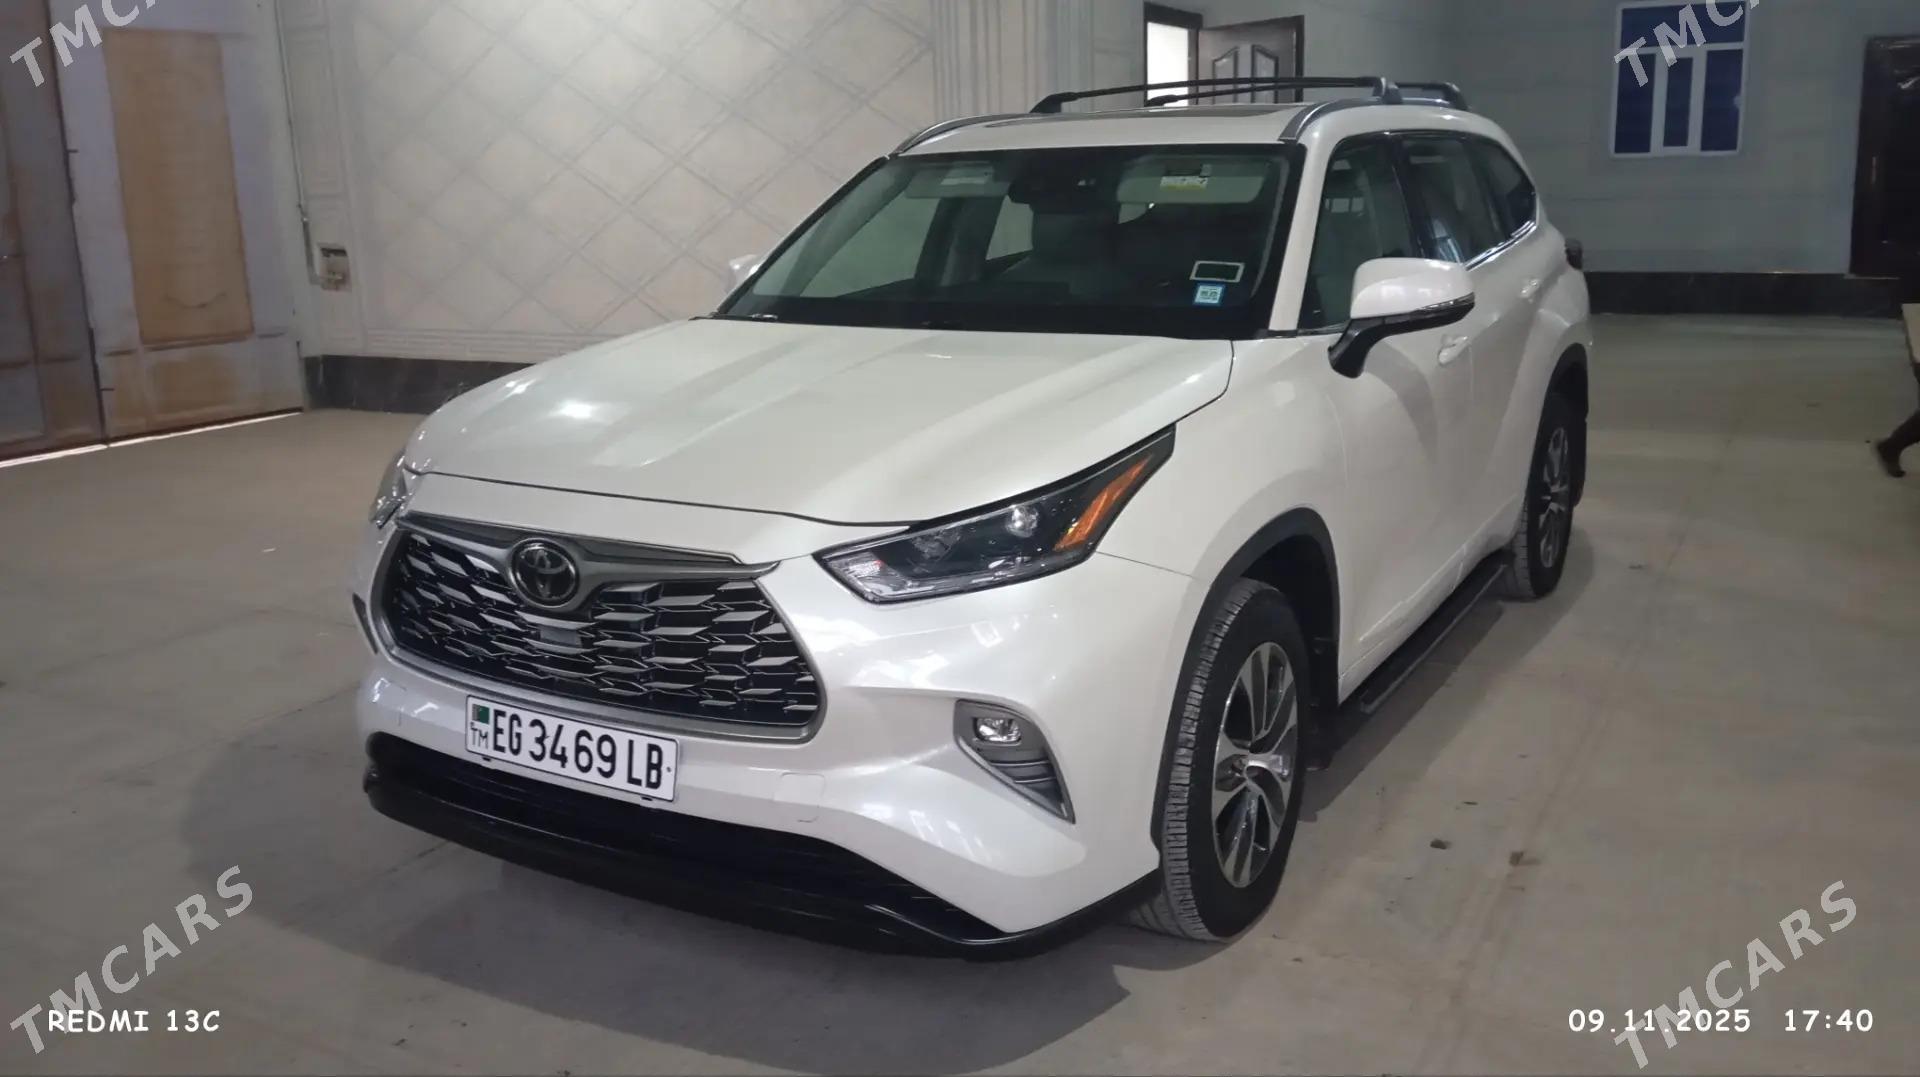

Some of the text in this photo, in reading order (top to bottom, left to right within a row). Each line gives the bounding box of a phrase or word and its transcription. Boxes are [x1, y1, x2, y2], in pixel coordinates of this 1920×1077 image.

[470, 727, 489, 750] TM
[493, 708, 664, 790] EG 3469 LB
